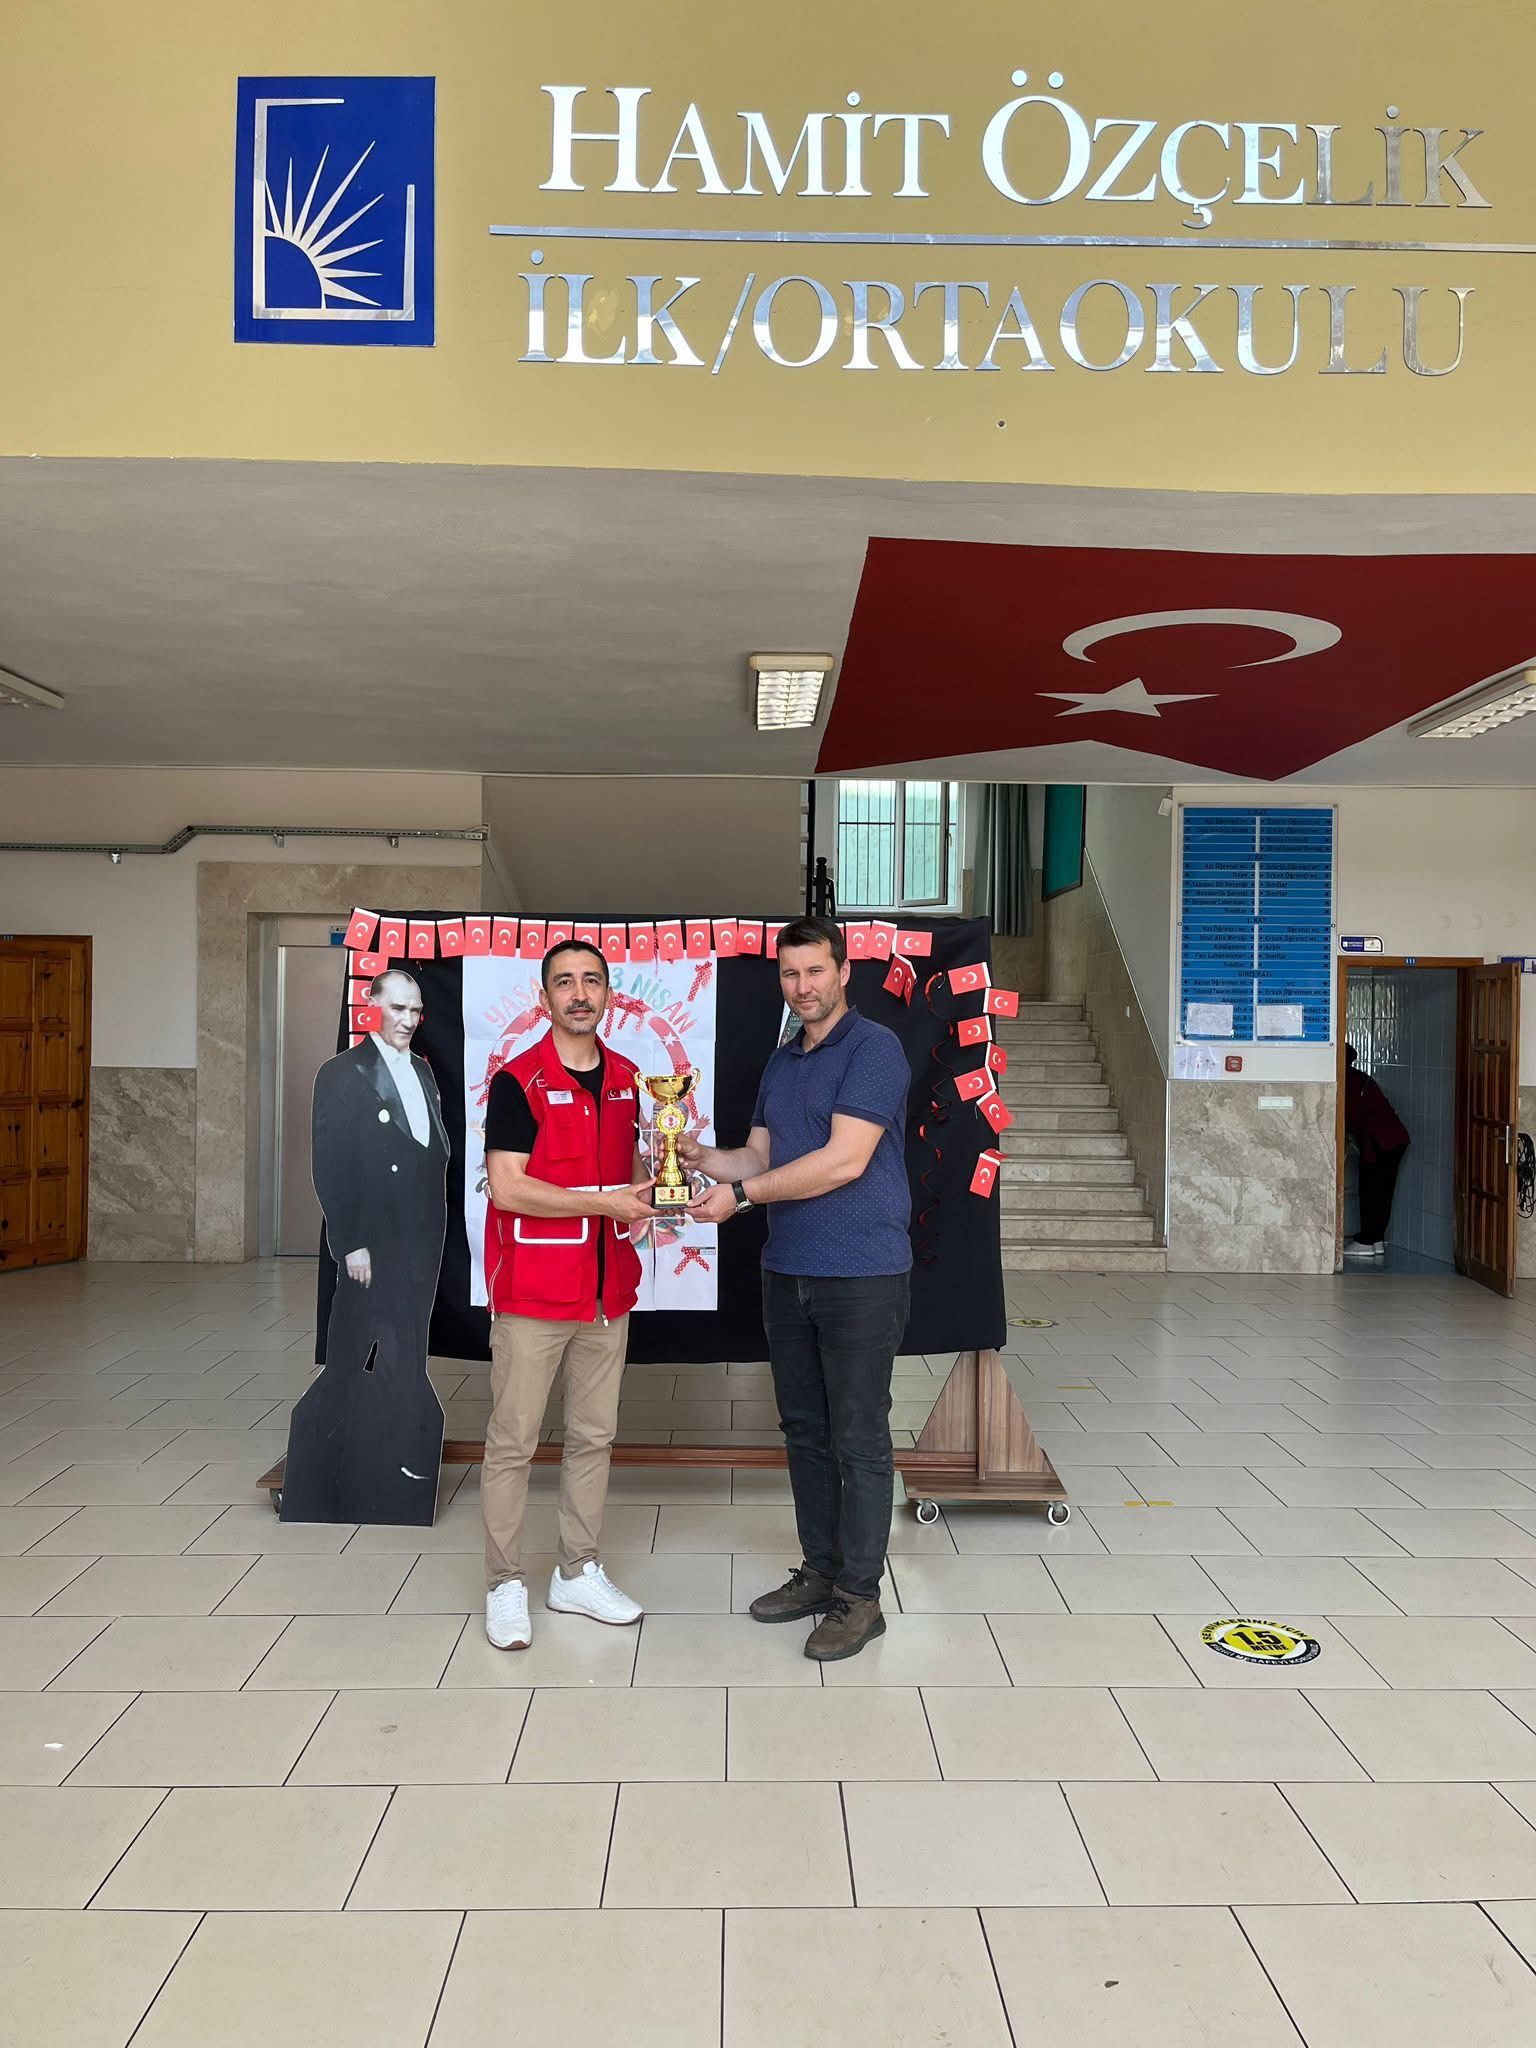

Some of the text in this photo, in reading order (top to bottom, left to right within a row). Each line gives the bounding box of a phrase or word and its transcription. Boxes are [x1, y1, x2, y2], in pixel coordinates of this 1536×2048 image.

[539, 69, 1492, 229] HAMİT ÖZÇELİK
[517, 249, 1476, 376] İLK/ORTAOKULU
[630, 973, 698, 1035] NİSAN
[1250, 1644, 1289, 1652] METRE
